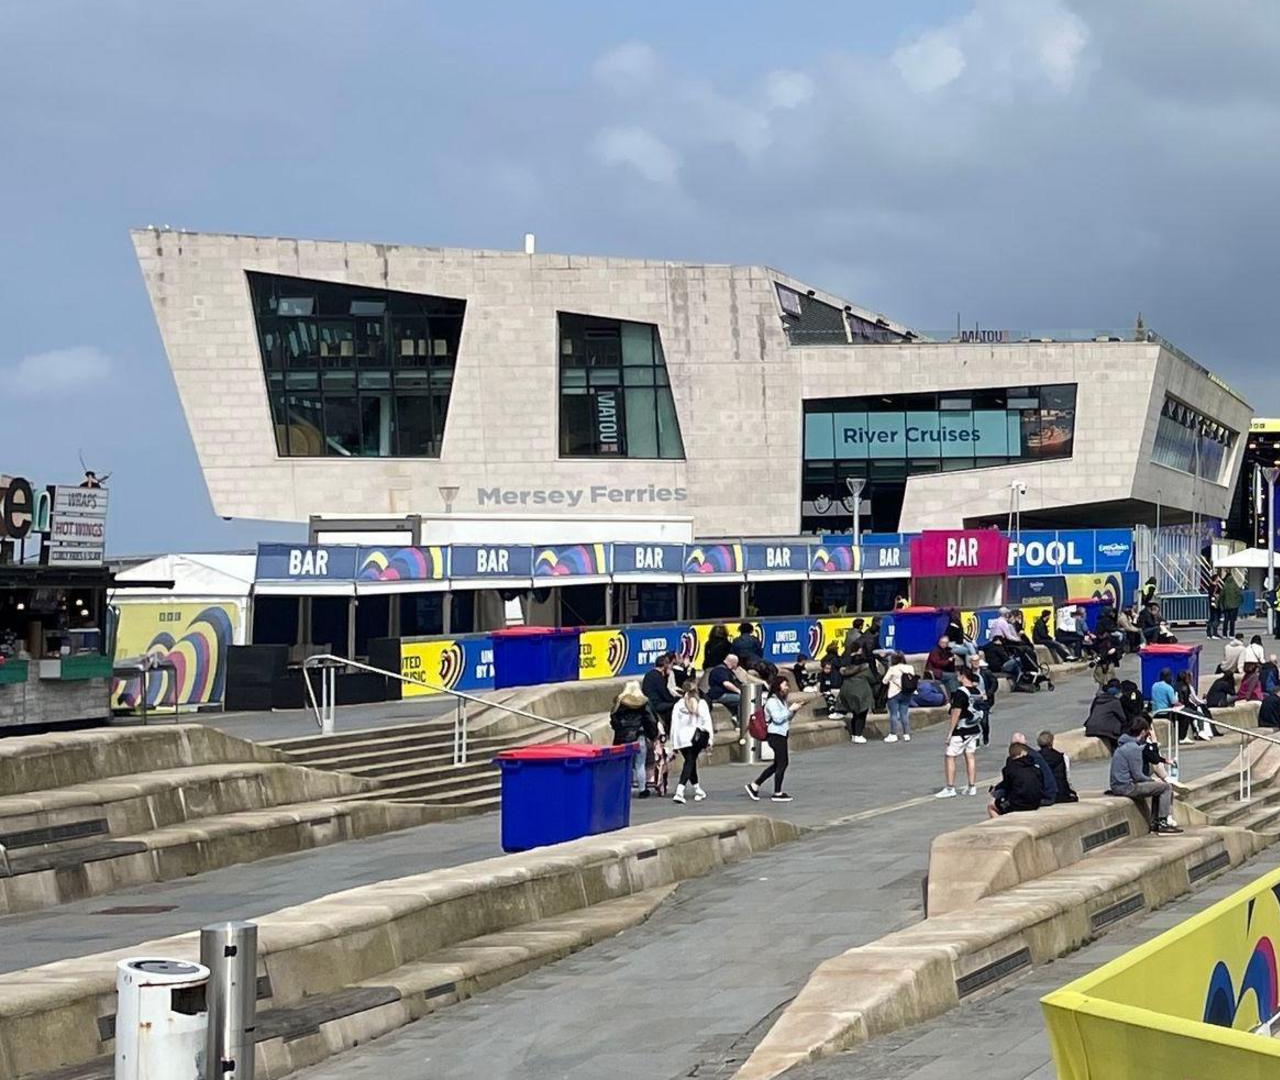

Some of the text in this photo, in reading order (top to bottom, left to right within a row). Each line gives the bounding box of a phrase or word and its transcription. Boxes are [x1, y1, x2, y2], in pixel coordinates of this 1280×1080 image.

[598, 391, 617, 442] MATOU
[843, 425, 981, 444] River Cruises
[68, 492, 98, 509] WRAPS
[477, 484, 688, 507] Mersey Ferries
[55, 522, 103, 537] HOT WINGS
[477, 549, 508, 573] BAR
[636, 547, 664, 569] BAR
[766, 547, 791, 568] BAR
[880, 548, 900, 566] BAR
[947, 538, 978, 567] BAR
[1007, 541, 1083, 566] POOL
[289, 550, 328, 575] BAR
[776, 631, 797, 642] UNITED
[772, 643, 800, 654] BY MUSIC
[402, 656, 421, 670] TED
[637, 652, 647, 665] BY
[476, 664, 488, 679] BY
